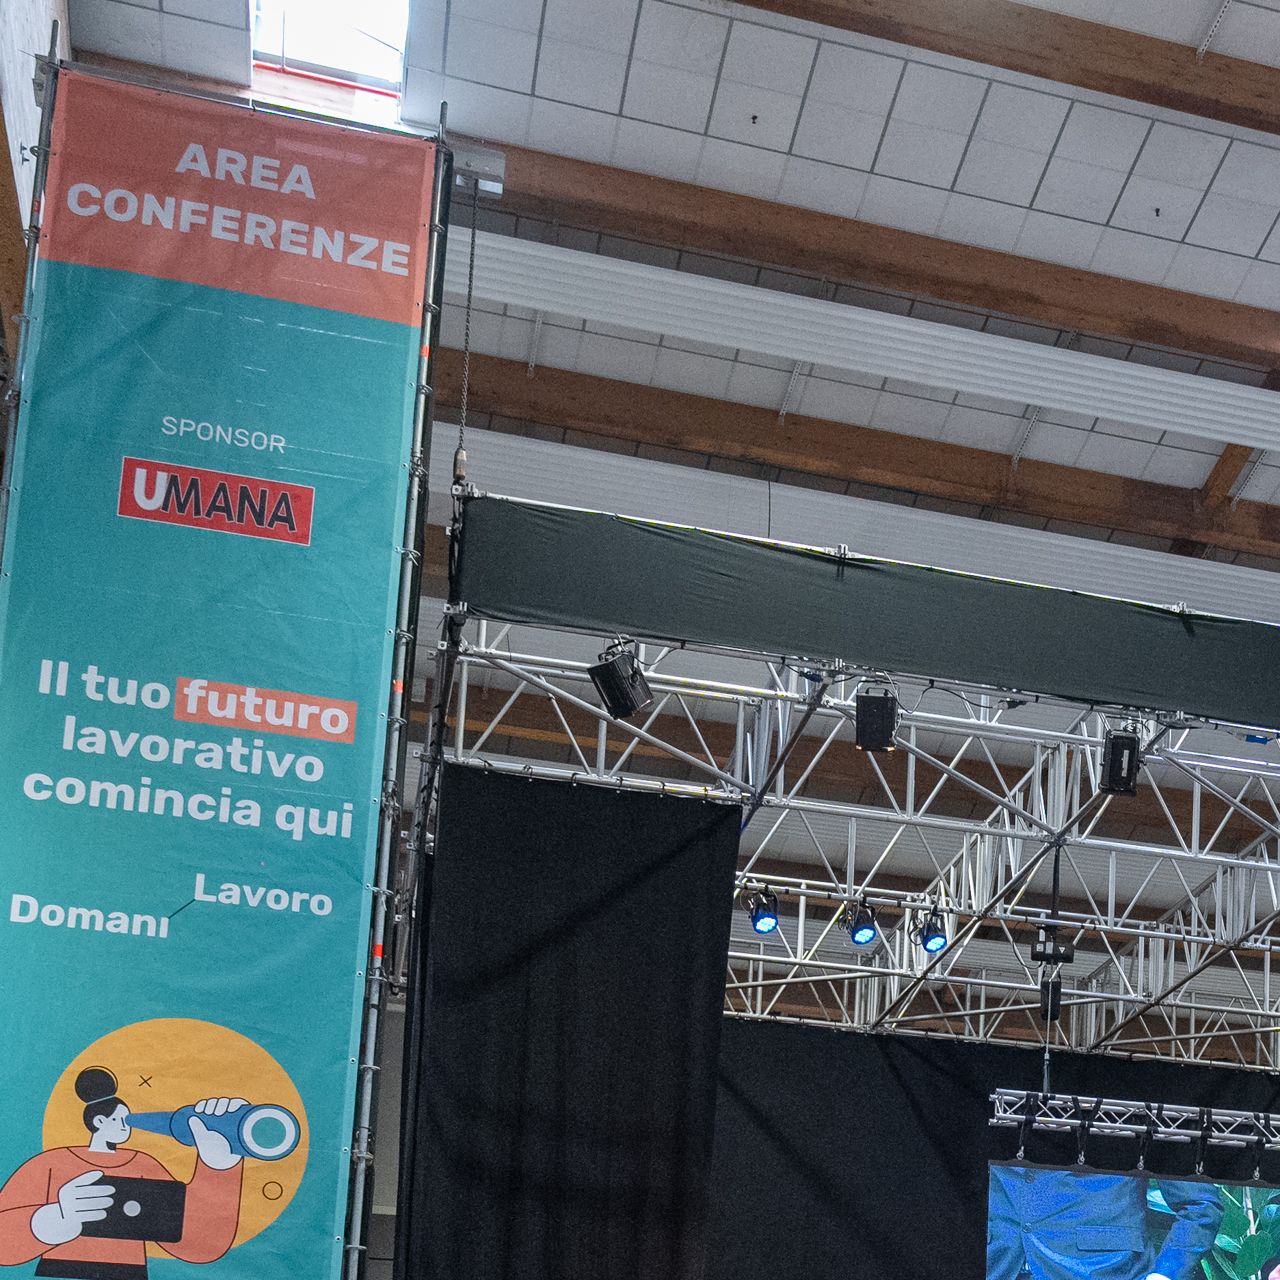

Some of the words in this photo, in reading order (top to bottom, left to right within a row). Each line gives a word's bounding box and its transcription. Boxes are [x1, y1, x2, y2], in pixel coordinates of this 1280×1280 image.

[176, 143, 316, 199] AREA
[66, 183, 411, 277] CONFERENZE
[161, 415, 286, 453] SPONSOR
[133, 467, 297, 533] UMANA
[39, 659, 69, 696] Il
[81, 665, 171, 709] tuo
[183, 679, 349, 734] futuro
[62, 715, 324, 782] lavorativo
[23, 772, 261, 827] comincia
[275, 803, 353, 841] qui
[9, 894, 169, 938] Domani
[194, 873, 333, 916] Lavoro
